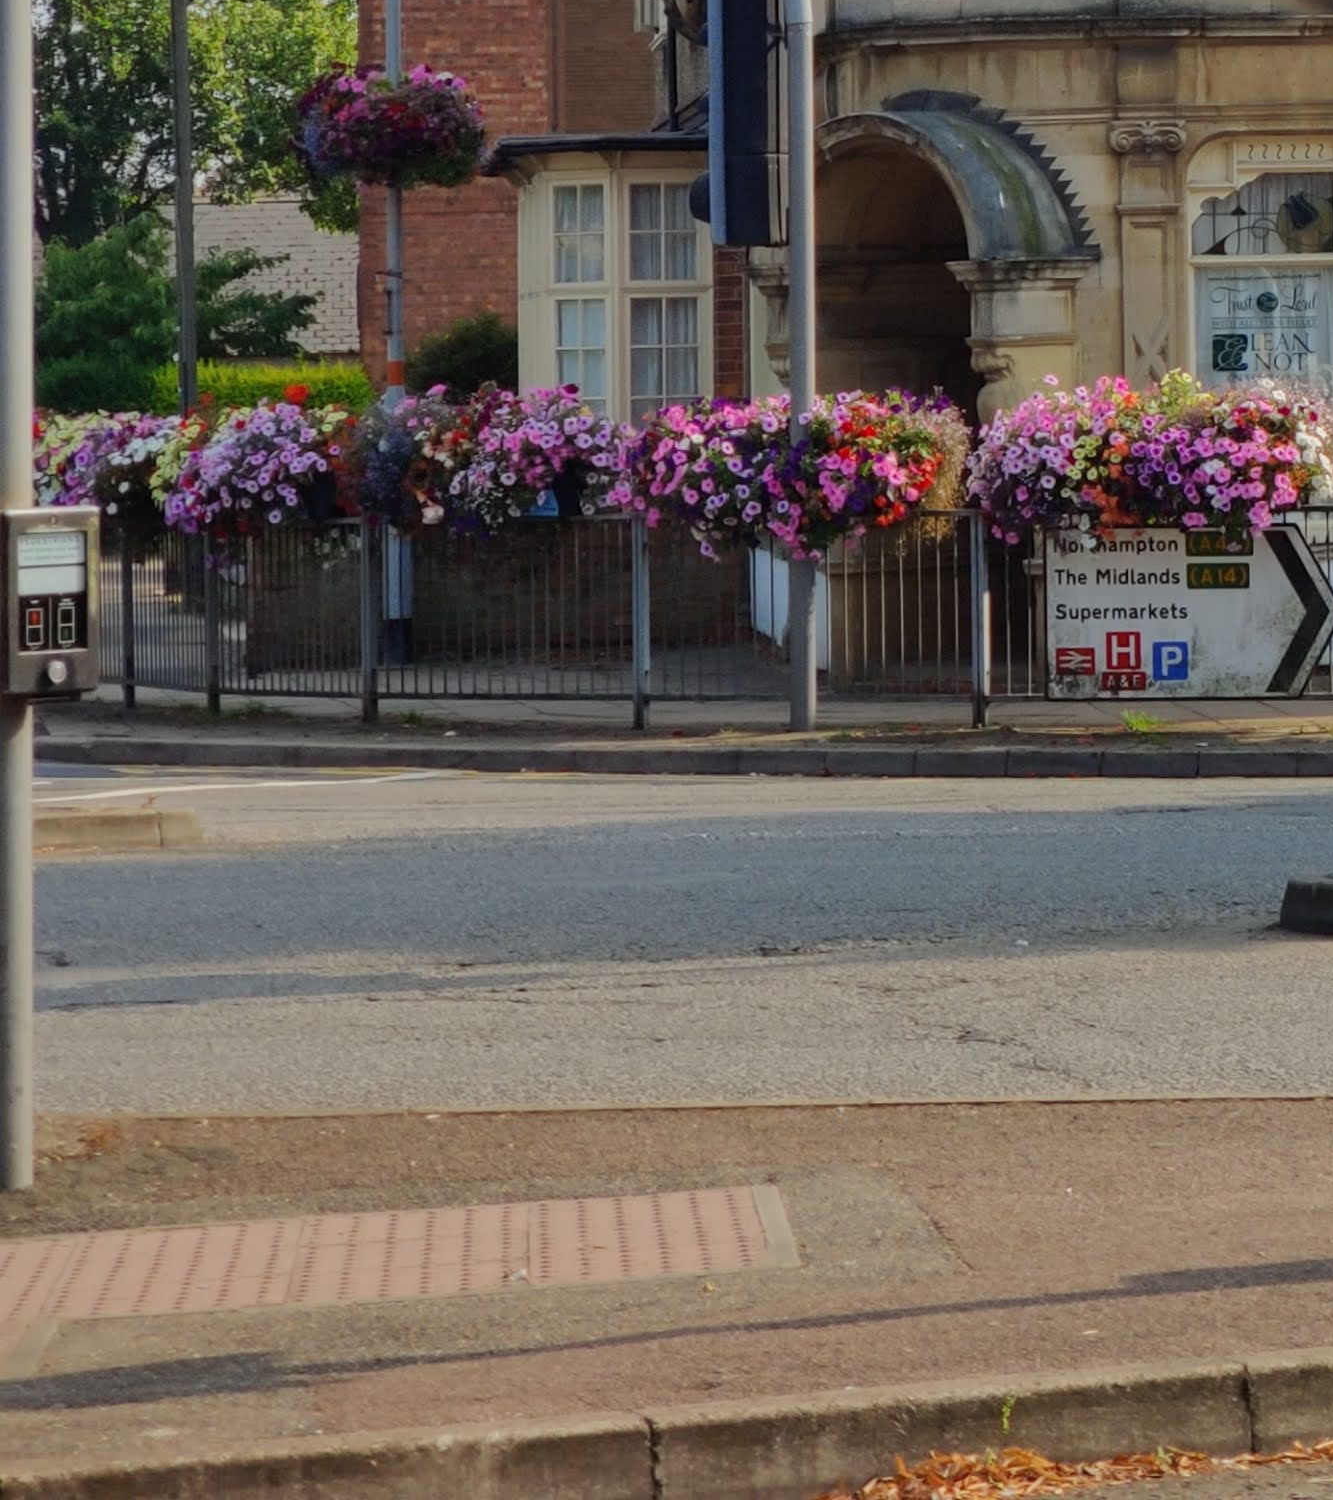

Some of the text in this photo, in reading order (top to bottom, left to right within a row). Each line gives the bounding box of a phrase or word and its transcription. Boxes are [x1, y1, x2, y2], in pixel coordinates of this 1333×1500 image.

[1251, 333, 1315, 353] LEAN
[1255, 352, 1308, 371] NOT
[1053, 537, 1179, 555] Norhampton
[1055, 565, 1246, 586] The Midlands (A14)
[1056, 604, 1188, 623] Supermarkets
[1111, 635, 1182, 677] H P
